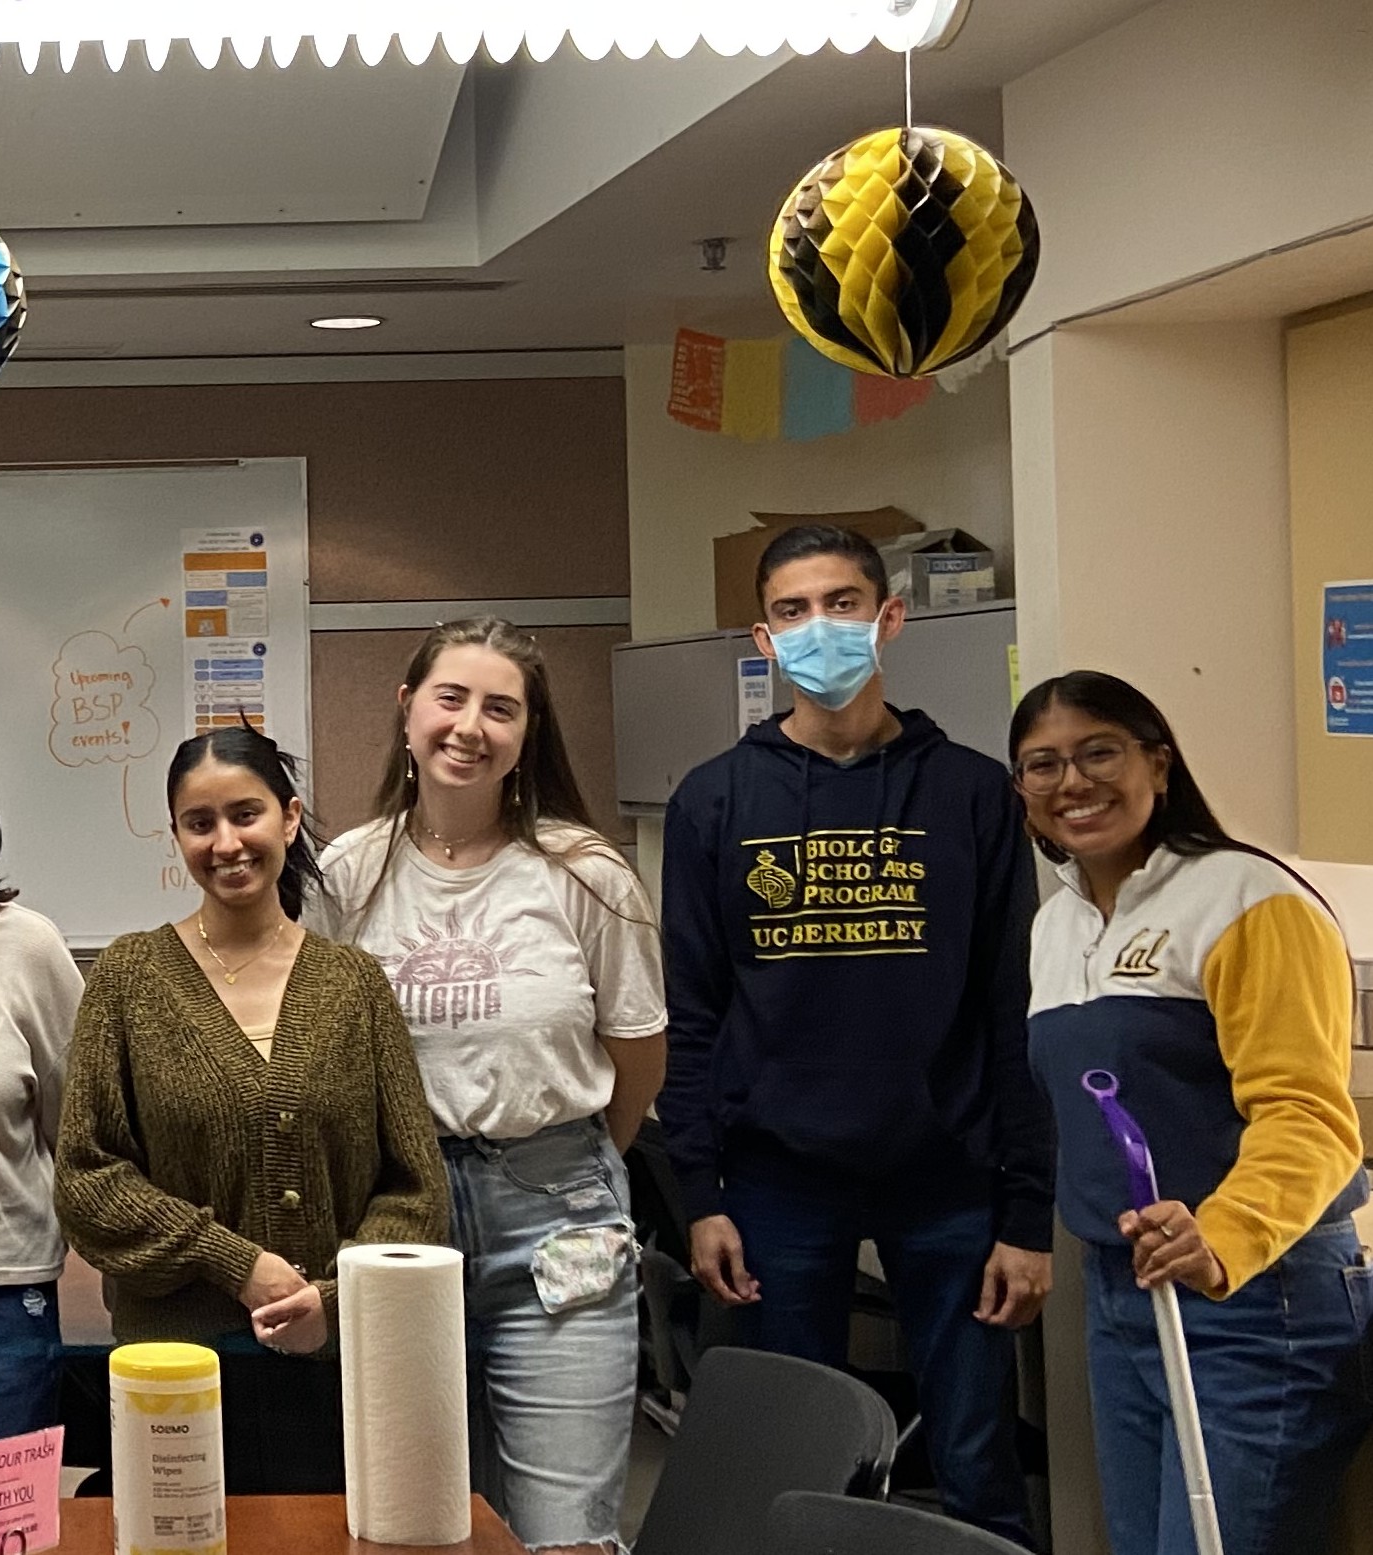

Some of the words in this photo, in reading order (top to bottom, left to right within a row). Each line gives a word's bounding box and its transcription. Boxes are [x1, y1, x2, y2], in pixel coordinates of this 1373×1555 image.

[71, 692, 123, 724] BSP
[806, 836, 902, 860] BIOLOG
[806, 860, 926, 882] SCHOARS
[803, 883, 917, 905] PROGRAM
[751, 926, 788, 948] UC
[791, 920, 926, 945] BERKELEY
[24, 1443, 56, 1464] TRASH
[152, 1466, 182, 1477] Wipes
[13, 1484, 34, 1504] YOU
